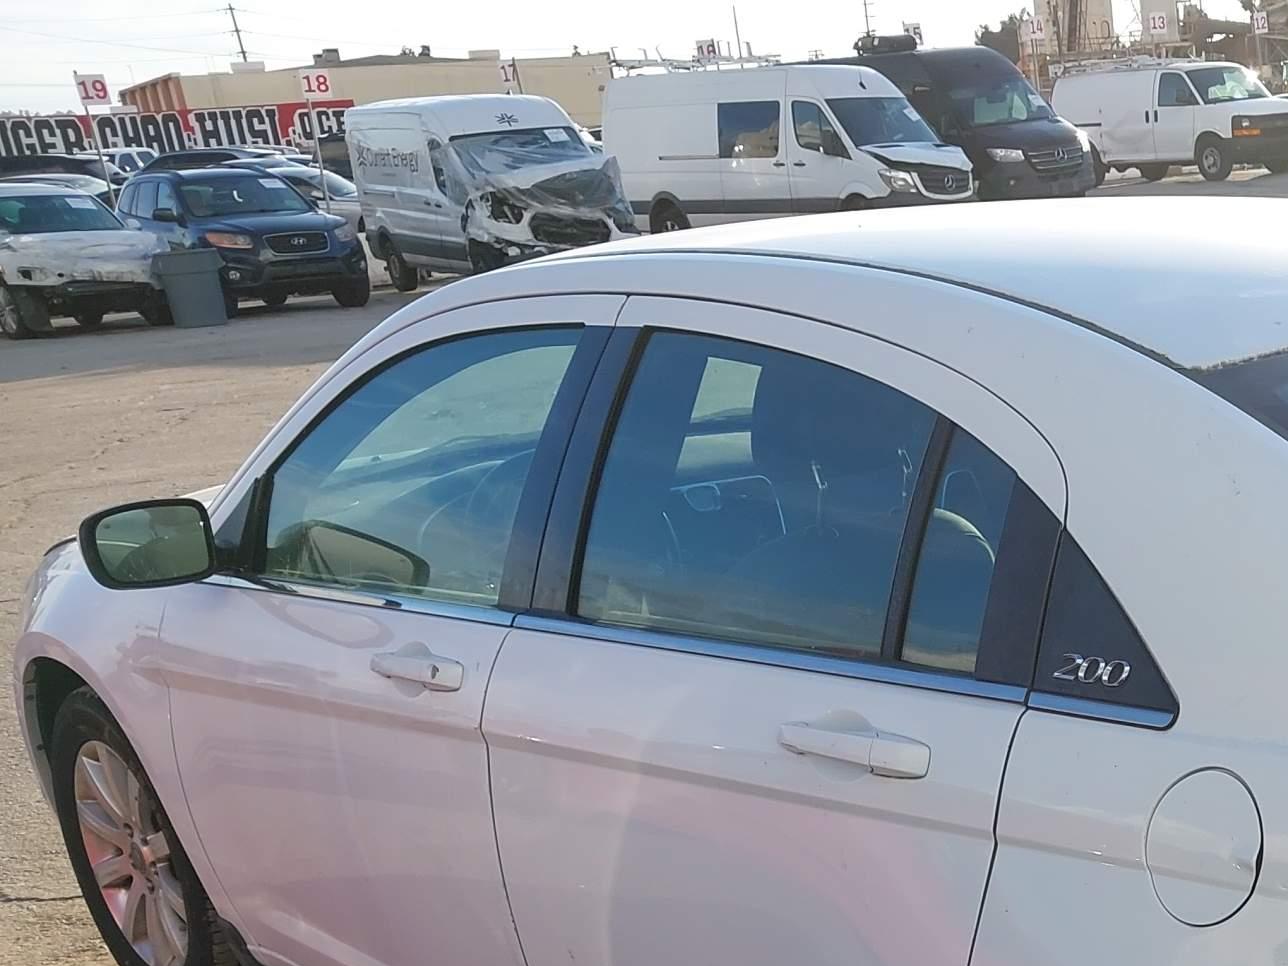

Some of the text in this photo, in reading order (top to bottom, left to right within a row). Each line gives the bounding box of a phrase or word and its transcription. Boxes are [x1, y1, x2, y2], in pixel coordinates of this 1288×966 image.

[1030, 19, 1043, 34] 14
[1152, 16, 1166, 30] 13
[1255, 16, 1267, 30] 12
[500, 63, 516, 82] 17
[78, 79, 108, 99] 19
[302, 74, 329, 93] 18
[1053, 653, 1131, 687] 200
